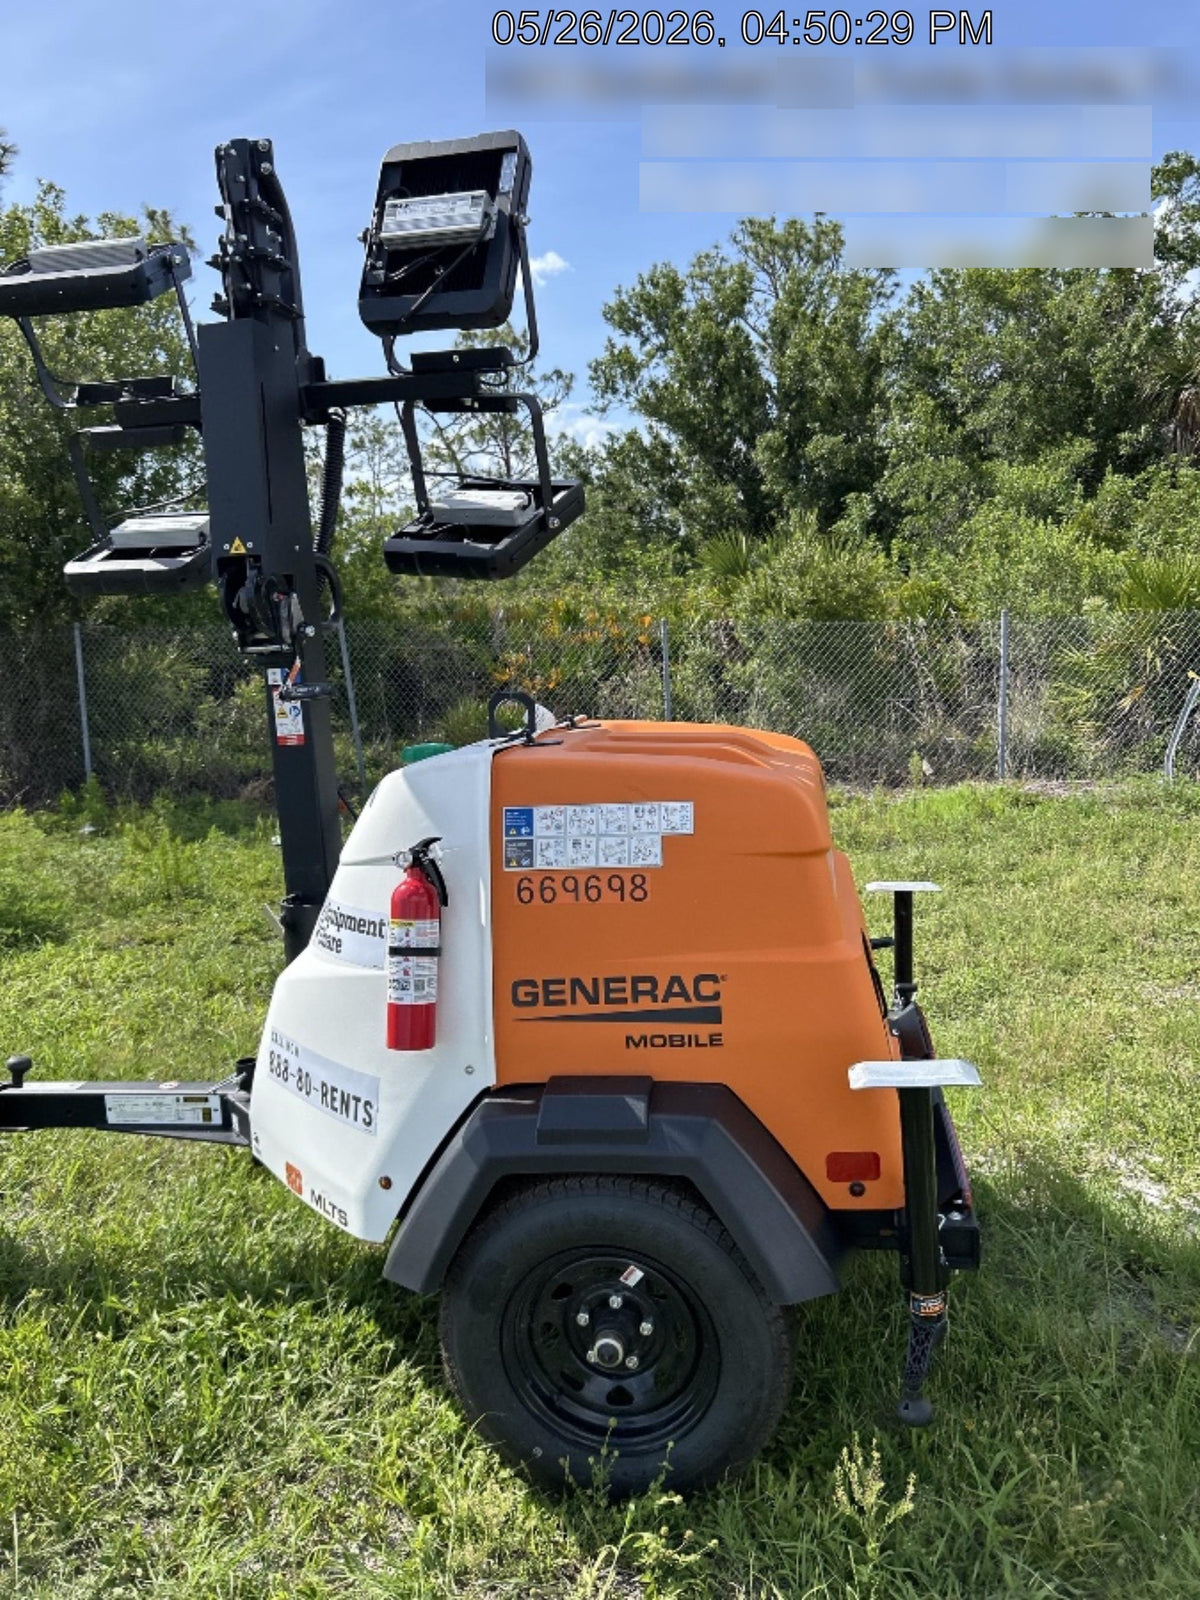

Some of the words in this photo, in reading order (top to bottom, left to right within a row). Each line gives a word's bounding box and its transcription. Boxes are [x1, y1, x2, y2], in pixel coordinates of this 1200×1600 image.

[516, 873, 648, 904] 669698
[511, 974, 722, 1008] GENERAC
[625, 1033, 724, 1049] MOBILE
[269, 1050, 374, 1128] 888-80-RENTS
[310, 1188, 348, 1227] MLTS
